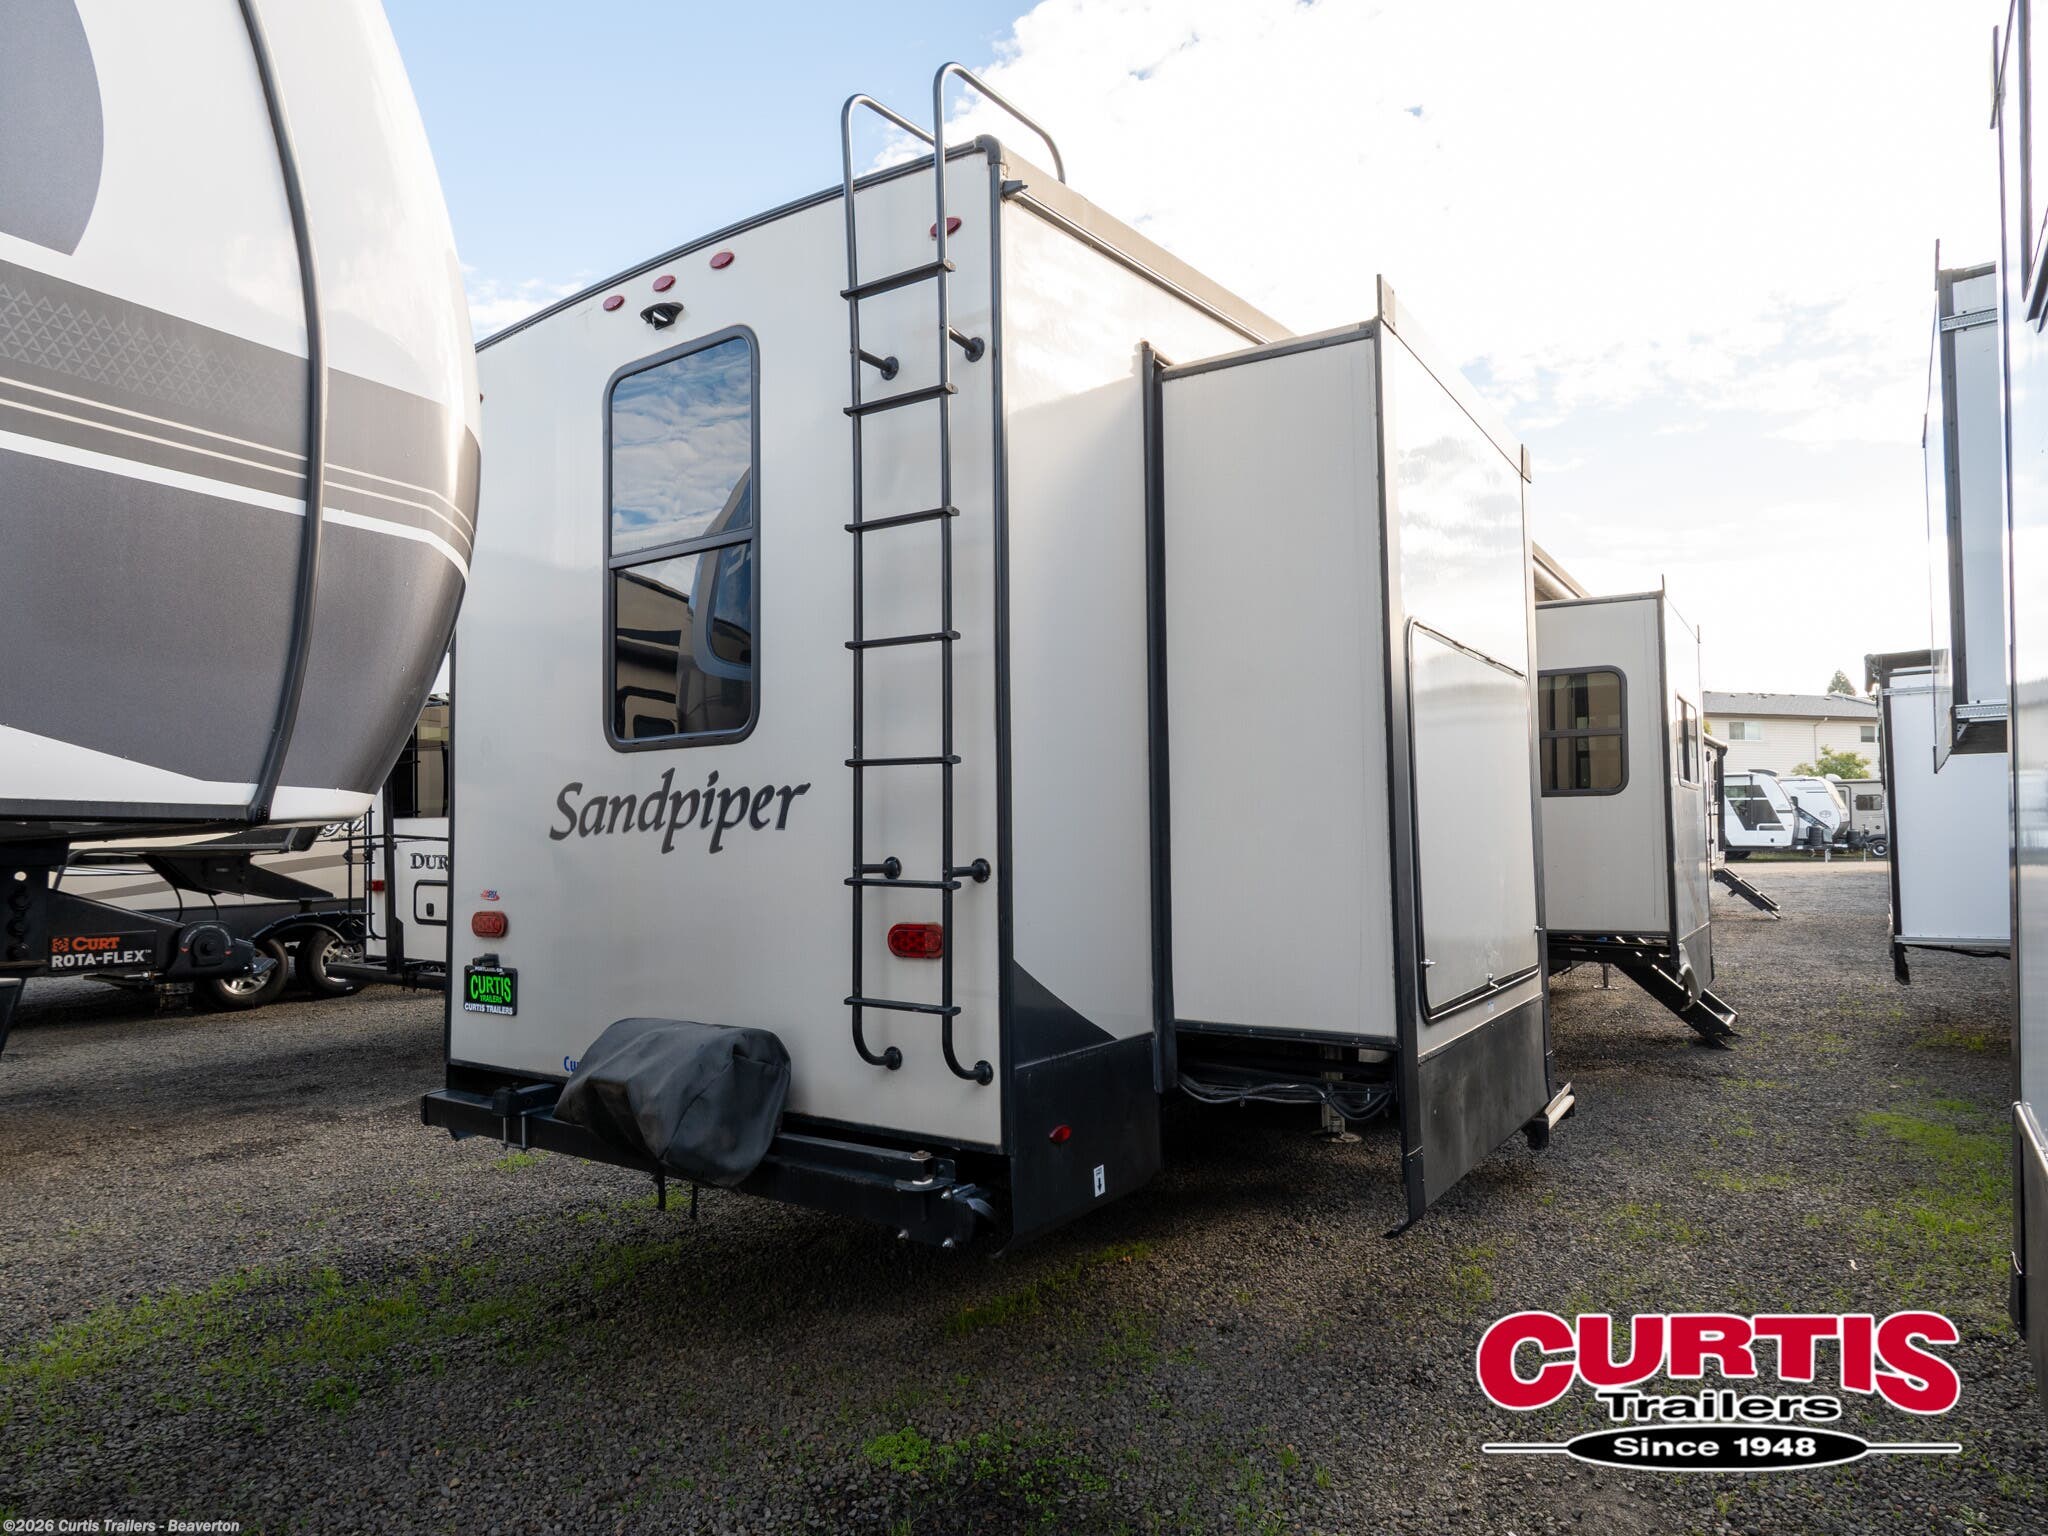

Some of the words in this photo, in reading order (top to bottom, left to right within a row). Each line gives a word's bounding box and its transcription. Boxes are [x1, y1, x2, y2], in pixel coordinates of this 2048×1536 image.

[549, 767, 811, 854] Sandpiper
[410, 852, 448, 872] DUR
[72, 937, 120, 950] CURT
[470, 975, 511, 1003] CURTIS
[480, 995, 503, 1004] TRAILERS
[464, 1002, 485, 1012] CURTIS
[486, 1004, 513, 1015] TRAILERS
